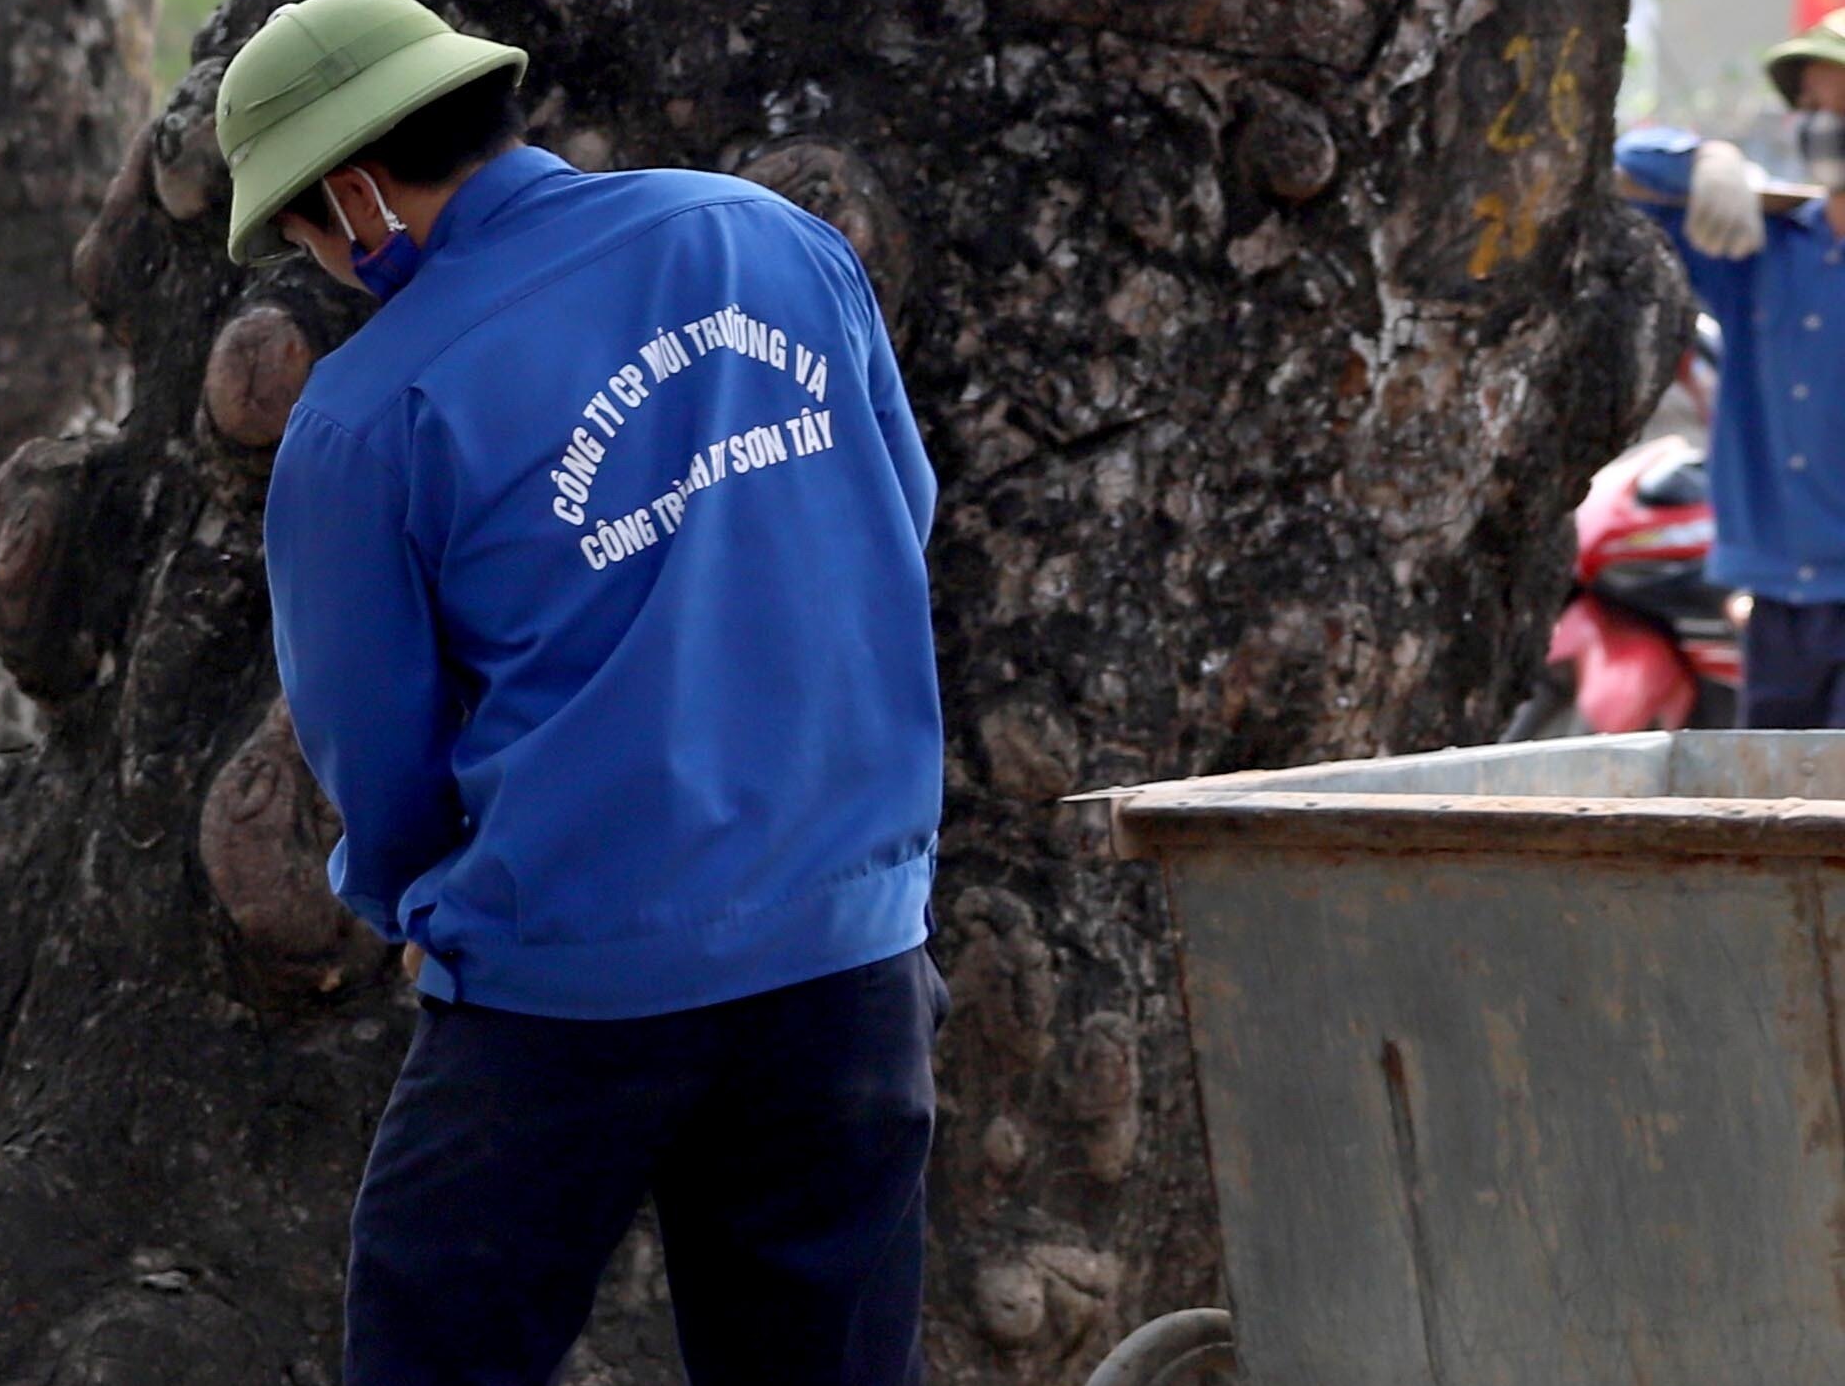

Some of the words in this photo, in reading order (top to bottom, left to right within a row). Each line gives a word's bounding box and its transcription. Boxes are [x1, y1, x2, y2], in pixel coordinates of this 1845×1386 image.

[550, 427, 606, 527] CÔNG
[582, 391, 626, 438] TY
[609, 363, 650, 409] CP
[639, 327, 692, 384] MÔI
[683, 303, 788, 371] TRƯỜNG
[795, 343, 828, 403] VÀ
[579, 508, 659, 571] CÔNG
[728, 424, 788, 474] SƠN
[786, 408, 834, 457] TÂY
